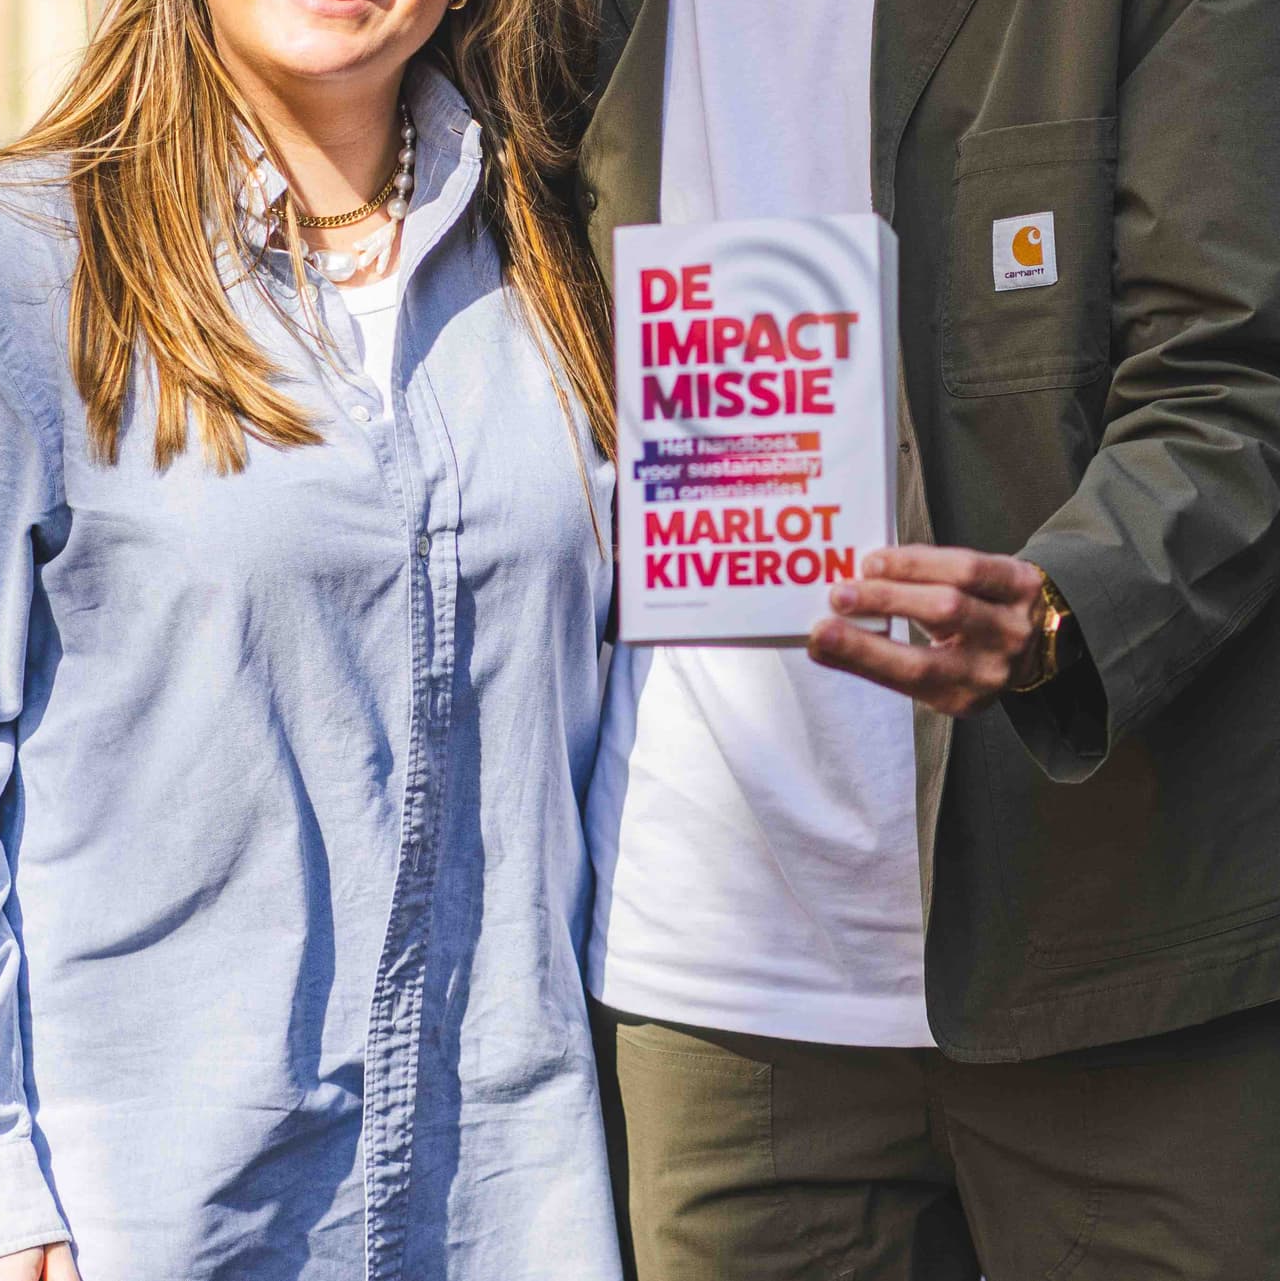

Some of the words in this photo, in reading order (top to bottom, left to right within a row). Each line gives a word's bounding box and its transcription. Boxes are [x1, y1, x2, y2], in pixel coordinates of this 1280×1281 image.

[641, 264, 712, 313] DE
[1004, 268, 1045, 279] carhartt
[642, 312, 859, 367] IMPACT
[643, 368, 835, 420] MISSIE
[658, 439, 692, 456] Het
[698, 434, 799, 455] handboek
[638, 464, 681, 480] voor
[688, 458, 819, 479] sustainability
[656, 483, 674, 500] in
[645, 505, 840, 546] MARLOT
[646, 547, 854, 588] KIVERON
